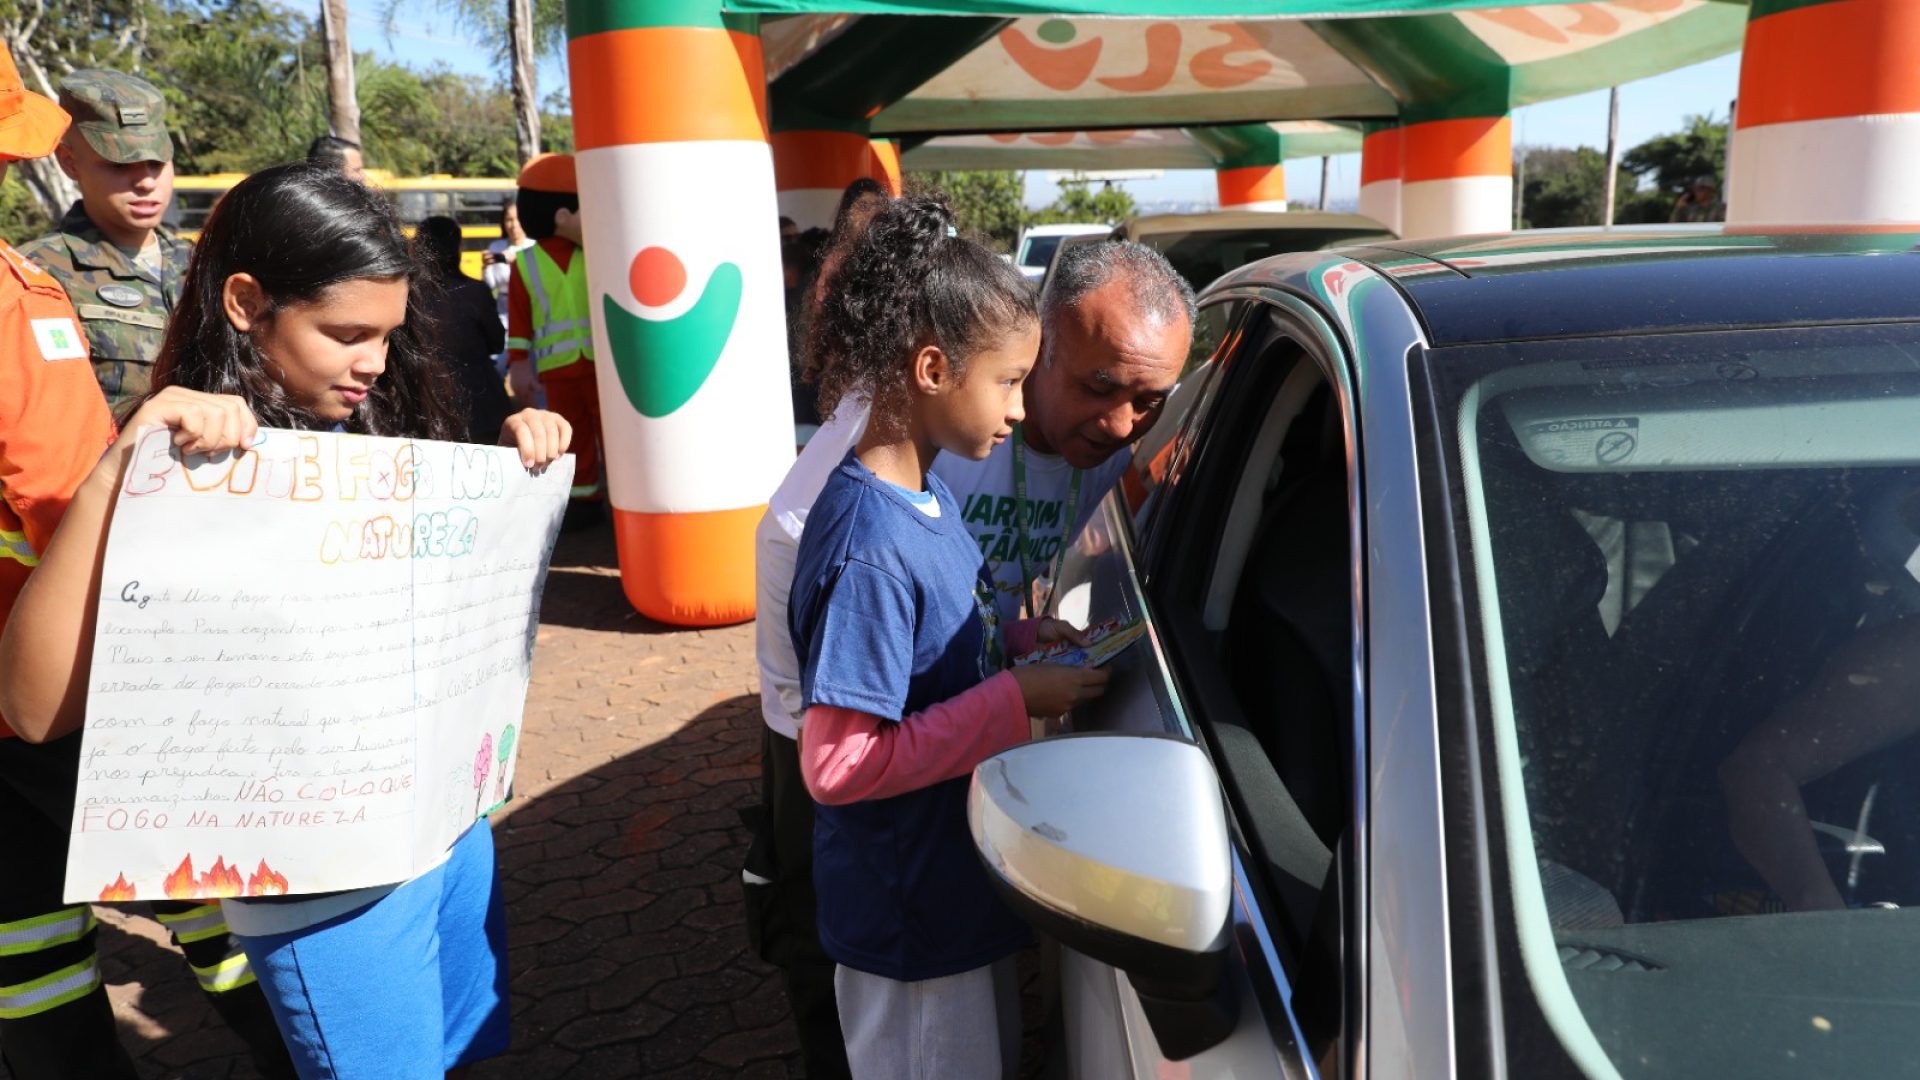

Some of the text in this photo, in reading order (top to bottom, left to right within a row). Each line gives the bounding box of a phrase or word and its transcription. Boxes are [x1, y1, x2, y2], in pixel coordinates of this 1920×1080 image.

[336, 433, 435, 501] FOGO
[450, 444, 504, 501] NA
[320, 506, 479, 565] NATUREZA
[234, 775, 285, 804] NÃO
[297, 774, 413, 801] COLOQUE
[80, 805, 367, 833] FOGO NA NATUREZA
